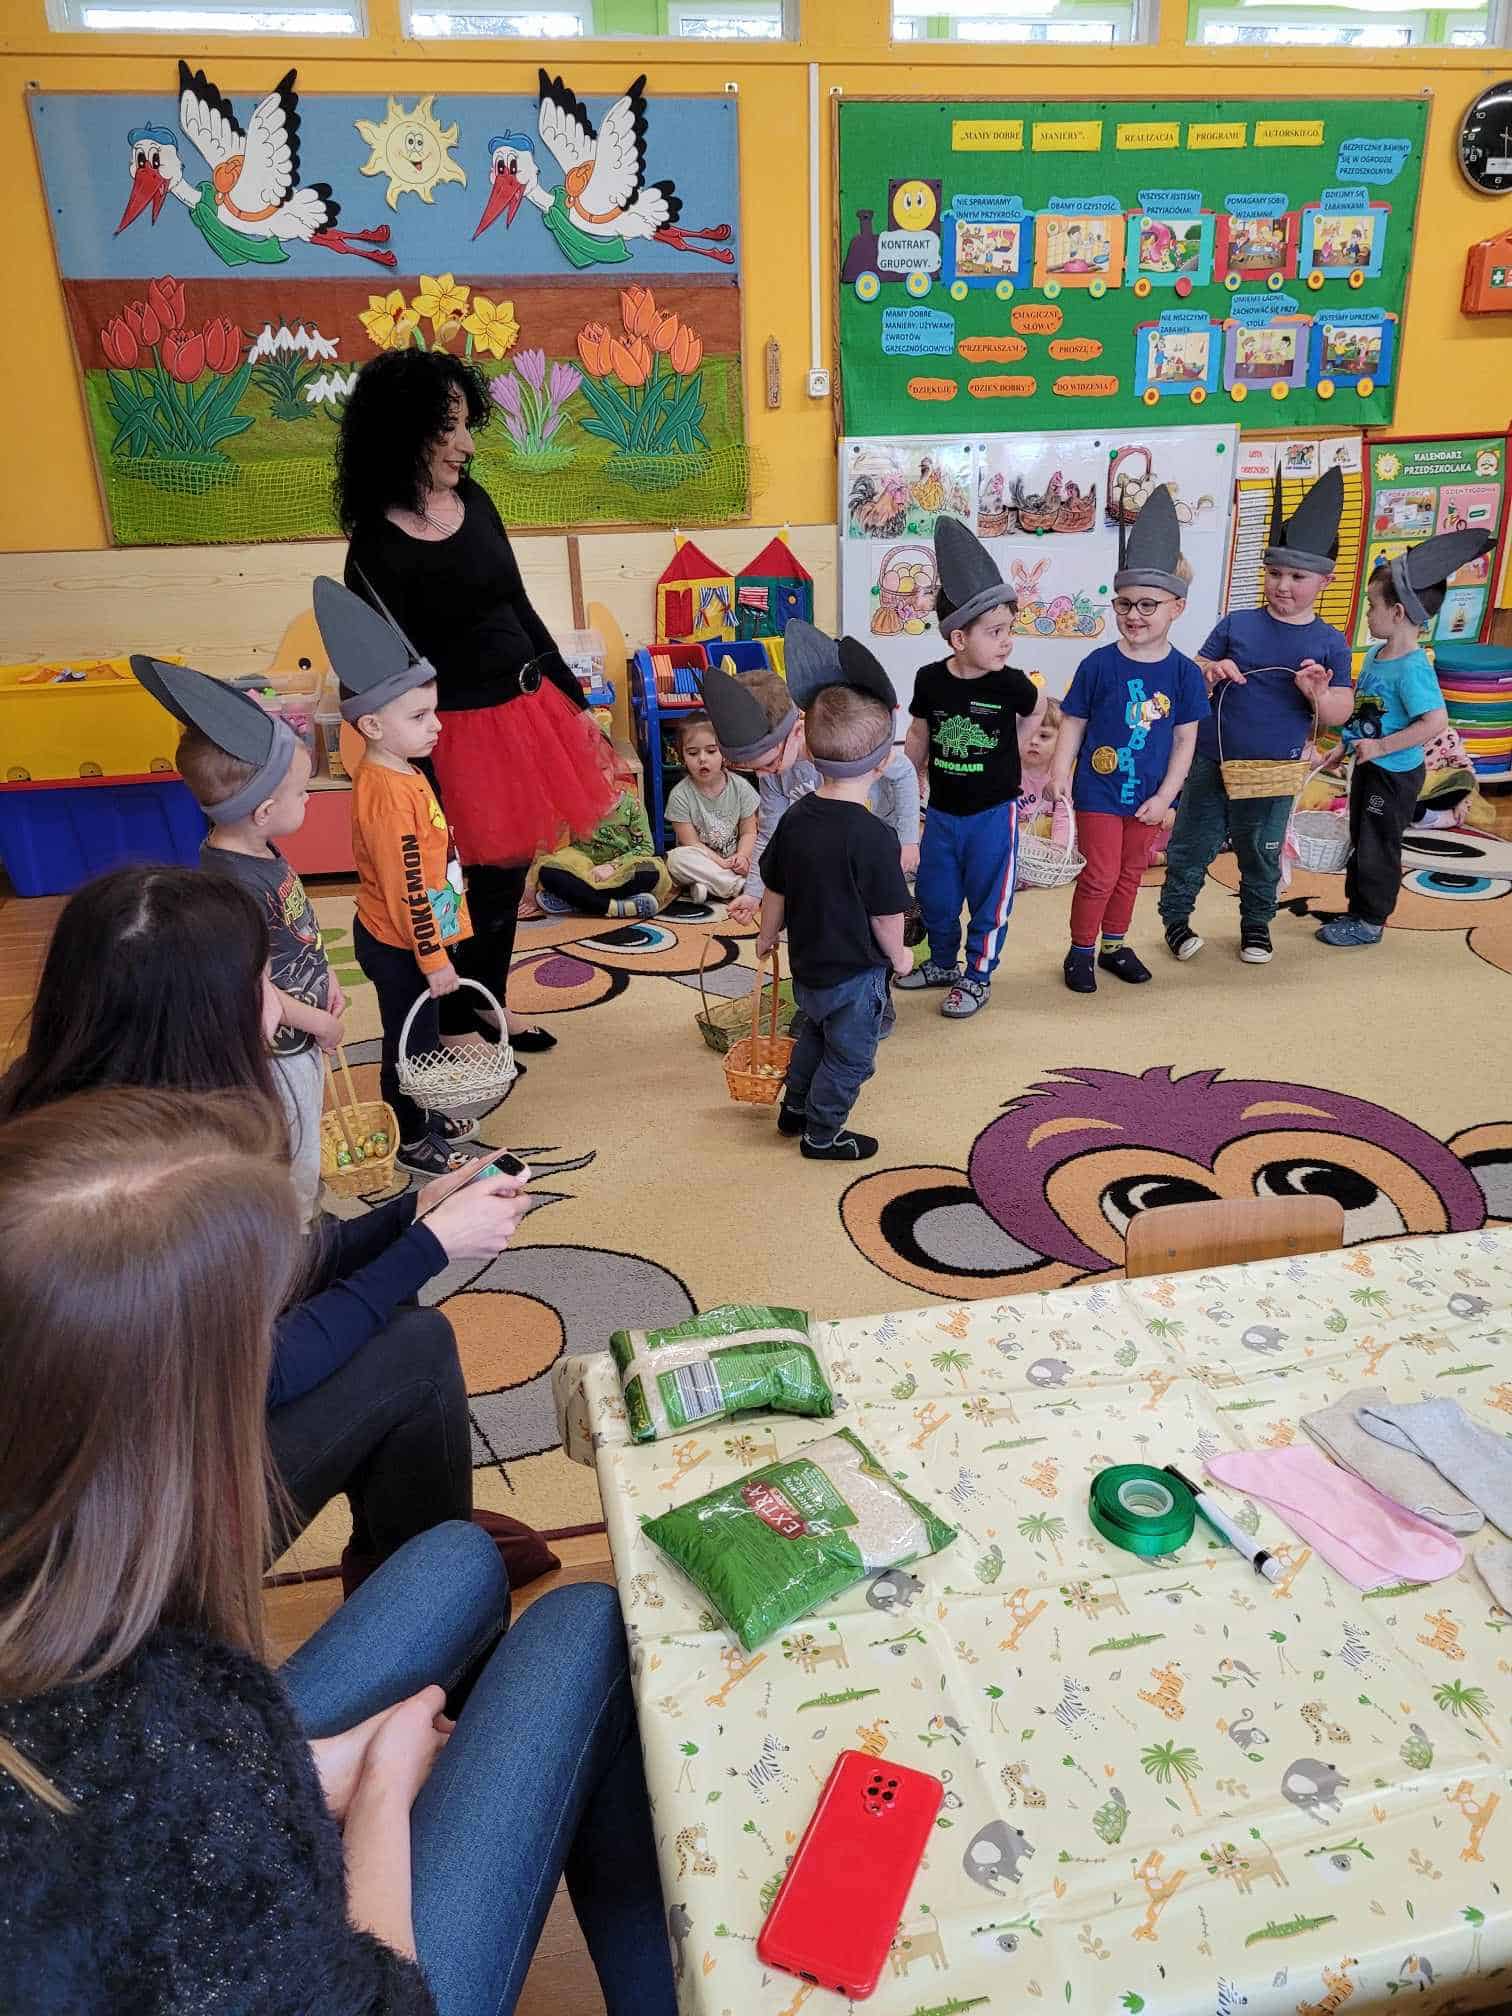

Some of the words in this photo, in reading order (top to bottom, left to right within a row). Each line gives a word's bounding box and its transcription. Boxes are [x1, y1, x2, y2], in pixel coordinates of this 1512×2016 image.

[1124, 132, 1174, 142] REALIZACJA
[1196, 131, 1239, 141] PROGRAMU
[1264, 128, 1319, 137] AUTORSKIEGO
[1352, 155, 1360, 163] W
[1140, 191, 1169, 200] WSZYSCY
[957, 198, 968, 206] NIE
[969, 198, 1012, 206] SPRAWIAMY
[881, 239, 930, 249] KONTRAKT
[880, 258, 931, 269] GRUPOWY.
[885, 310, 908, 318] MAMY
[909, 310, 932, 318] DOBRE
[1057, 383, 1068, 392] DO
[1414, 450, 1463, 462] KALENDARZ
[1403, 463, 1472, 475] PRZEDSZKOLAKA
[1117, 678, 1147, 804] RUBBLE
[934, 757, 984, 773] DINOSAUR
[401, 834, 441, 956] POKÉMON
[748, 1484, 801, 1533] EXTRA
